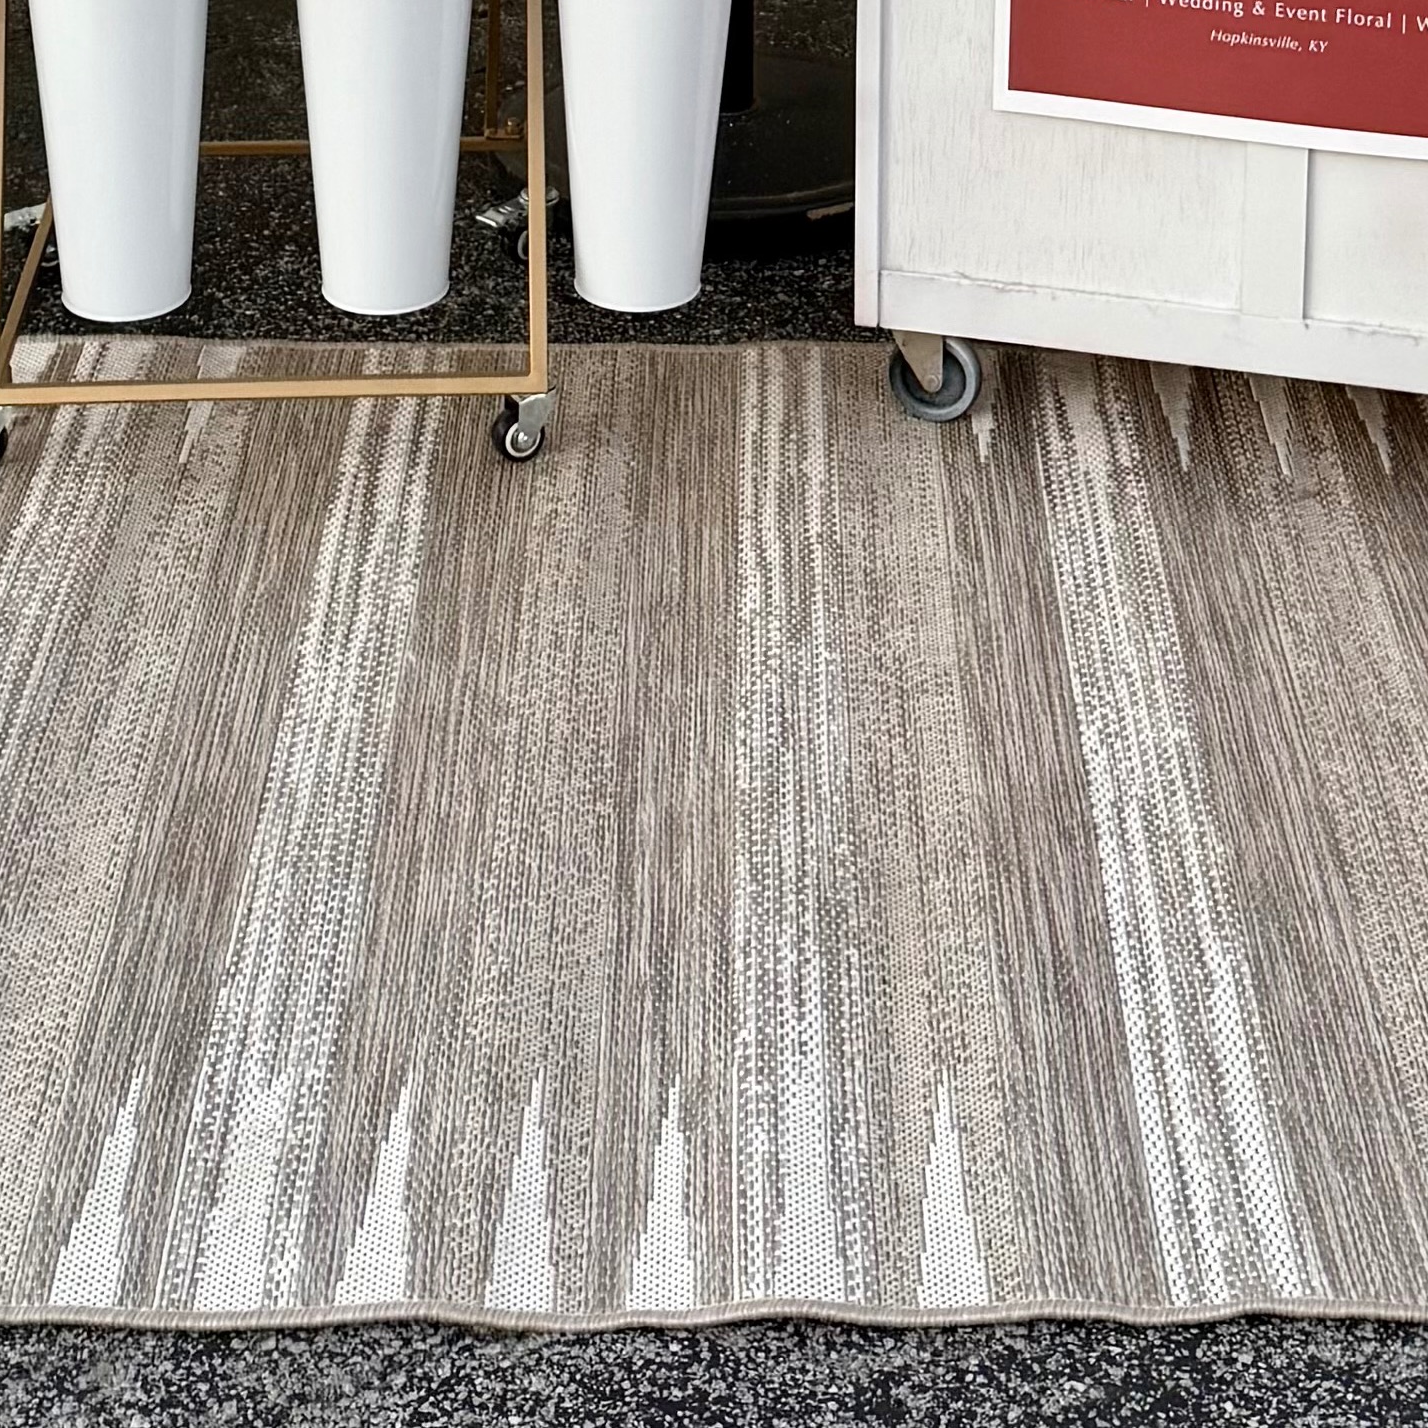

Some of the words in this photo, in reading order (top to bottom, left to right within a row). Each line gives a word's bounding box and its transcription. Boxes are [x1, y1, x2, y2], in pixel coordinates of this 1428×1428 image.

[1252, 0, 1266, 16] &
[1275, 2, 1327, 23] Event
[1335, 8, 1392, 29] Floral
[1210, 29, 1303, 53] Hopkinsville,
[1308, 39, 1329, 53] KY
